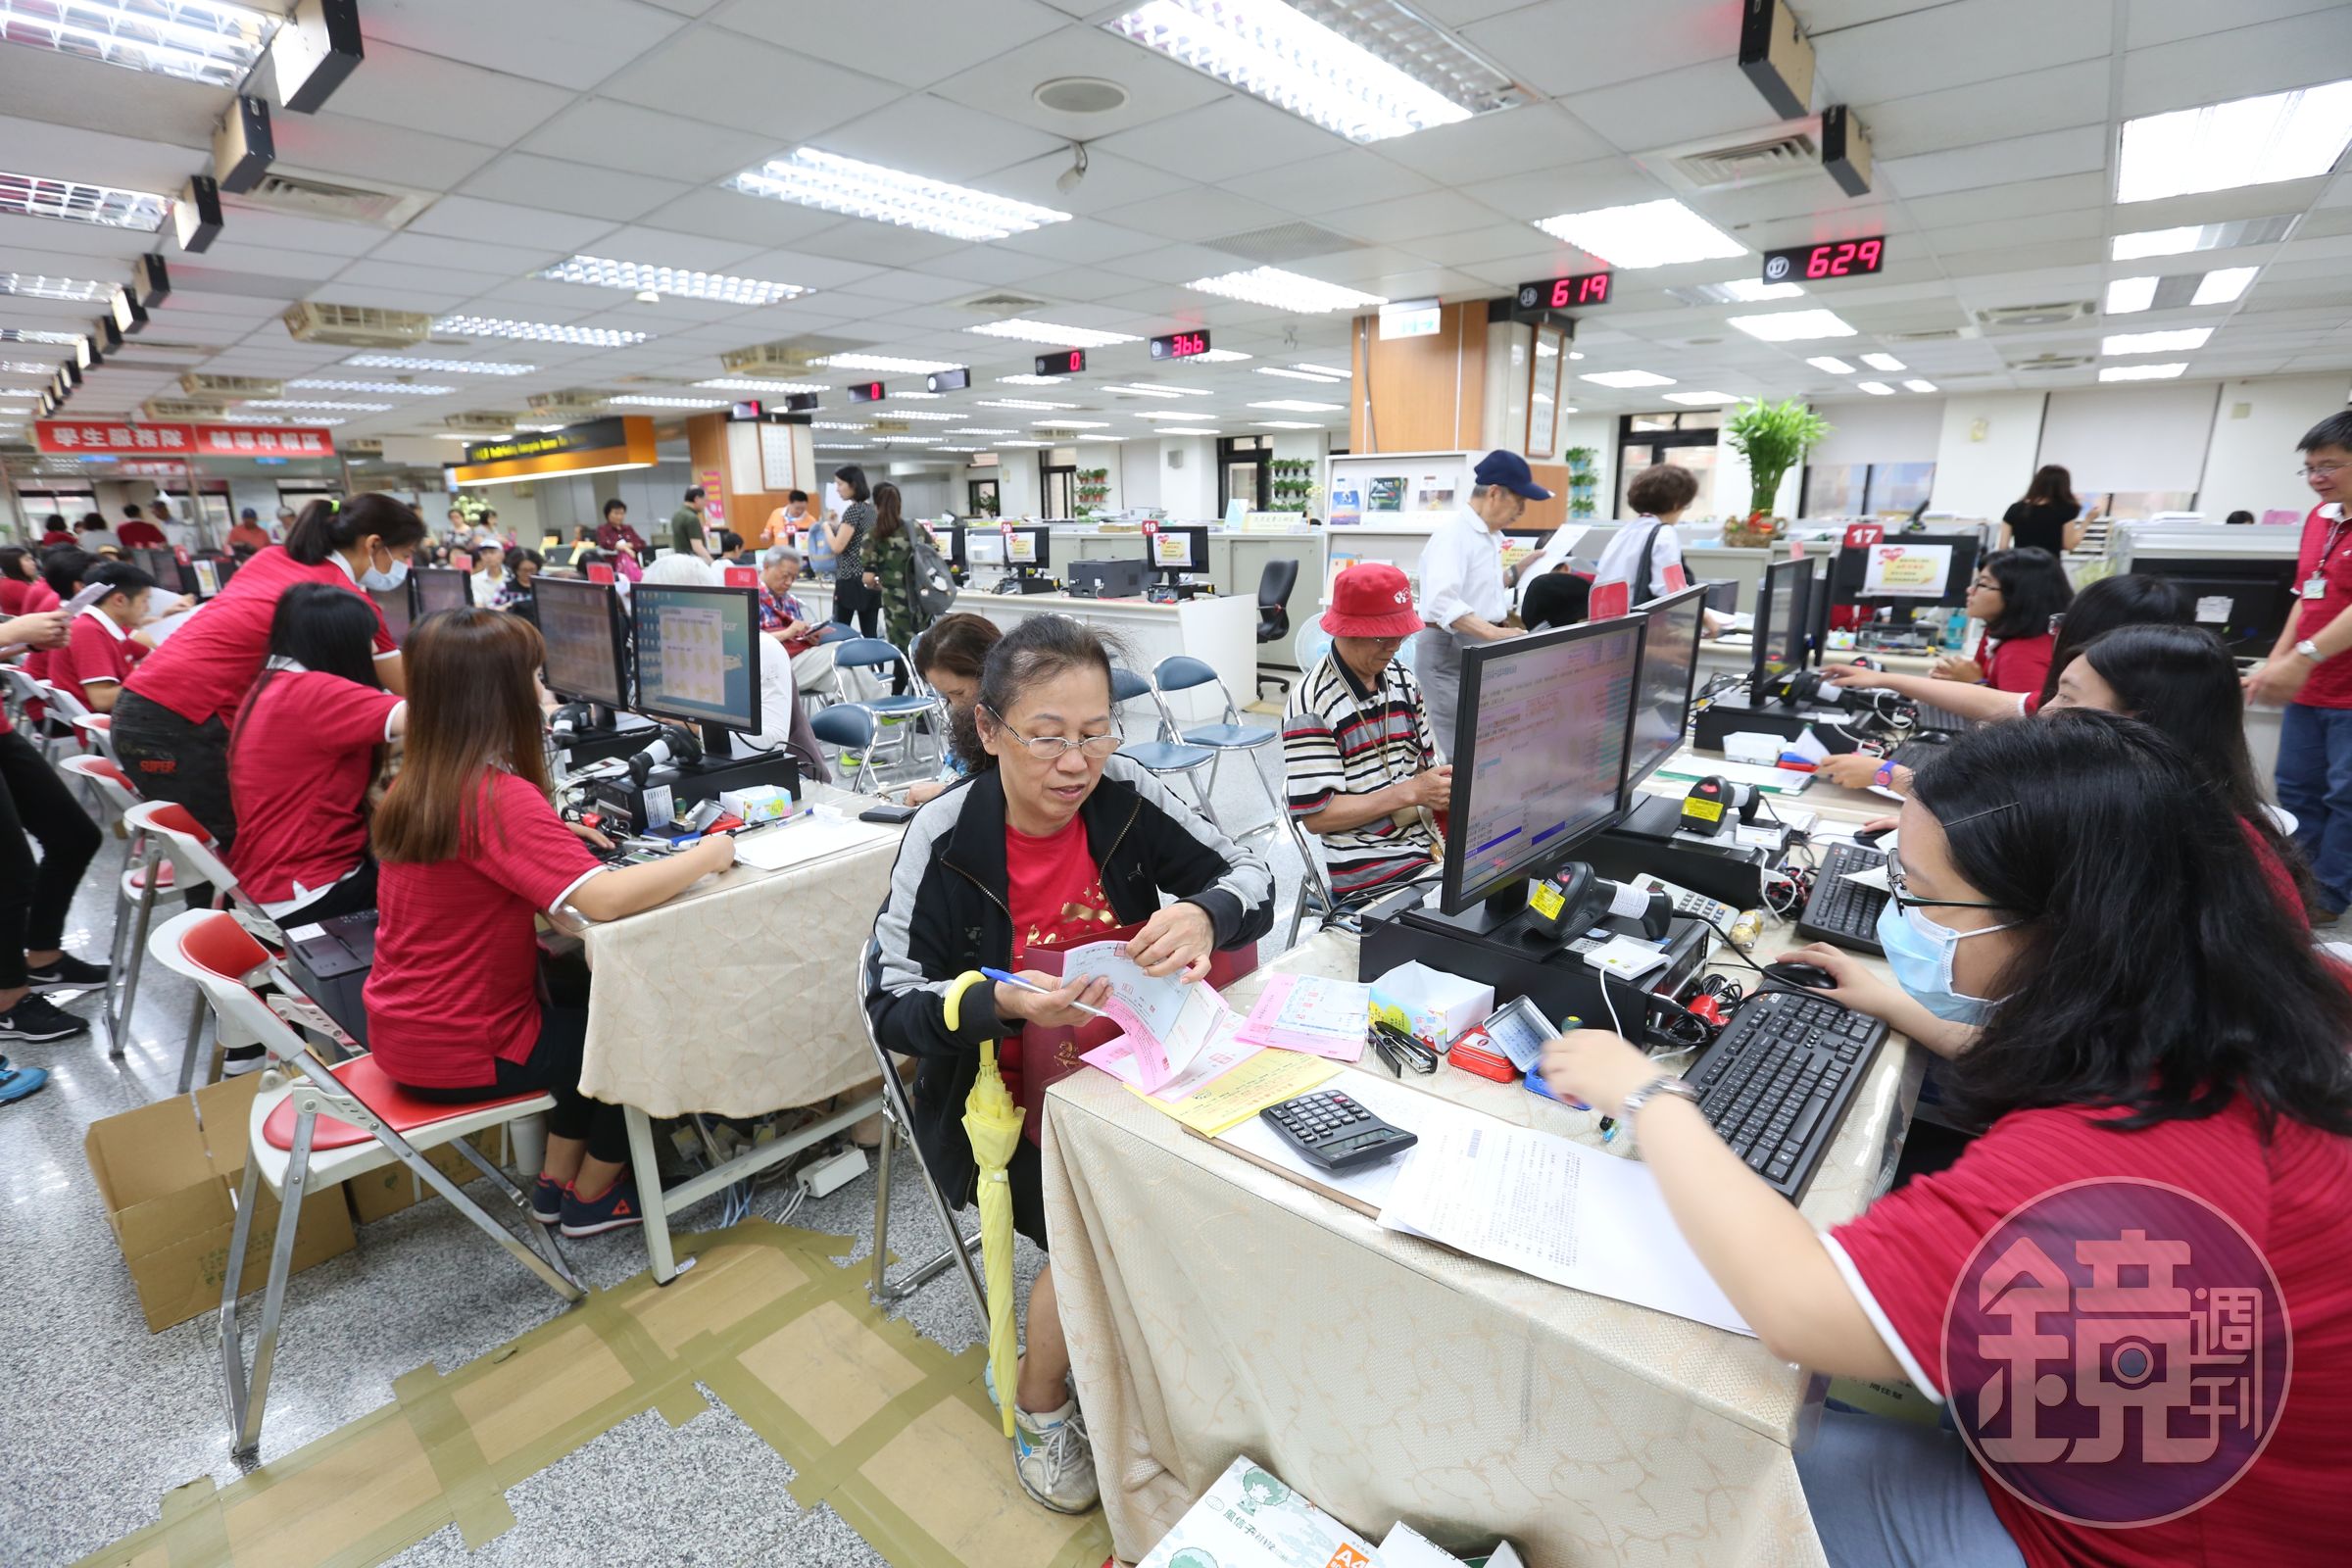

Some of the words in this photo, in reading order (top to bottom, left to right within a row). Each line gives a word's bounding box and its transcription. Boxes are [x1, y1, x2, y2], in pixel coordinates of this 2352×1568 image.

[1806, 240, 1882, 278] 629
[1551, 274, 1607, 309] 619
[1069, 351, 1081, 371] 0
[1144, 522, 1156, 533] 19
[1851, 529, 1878, 544] 17
[1223, 1509, 1256, 1535] 風信子
